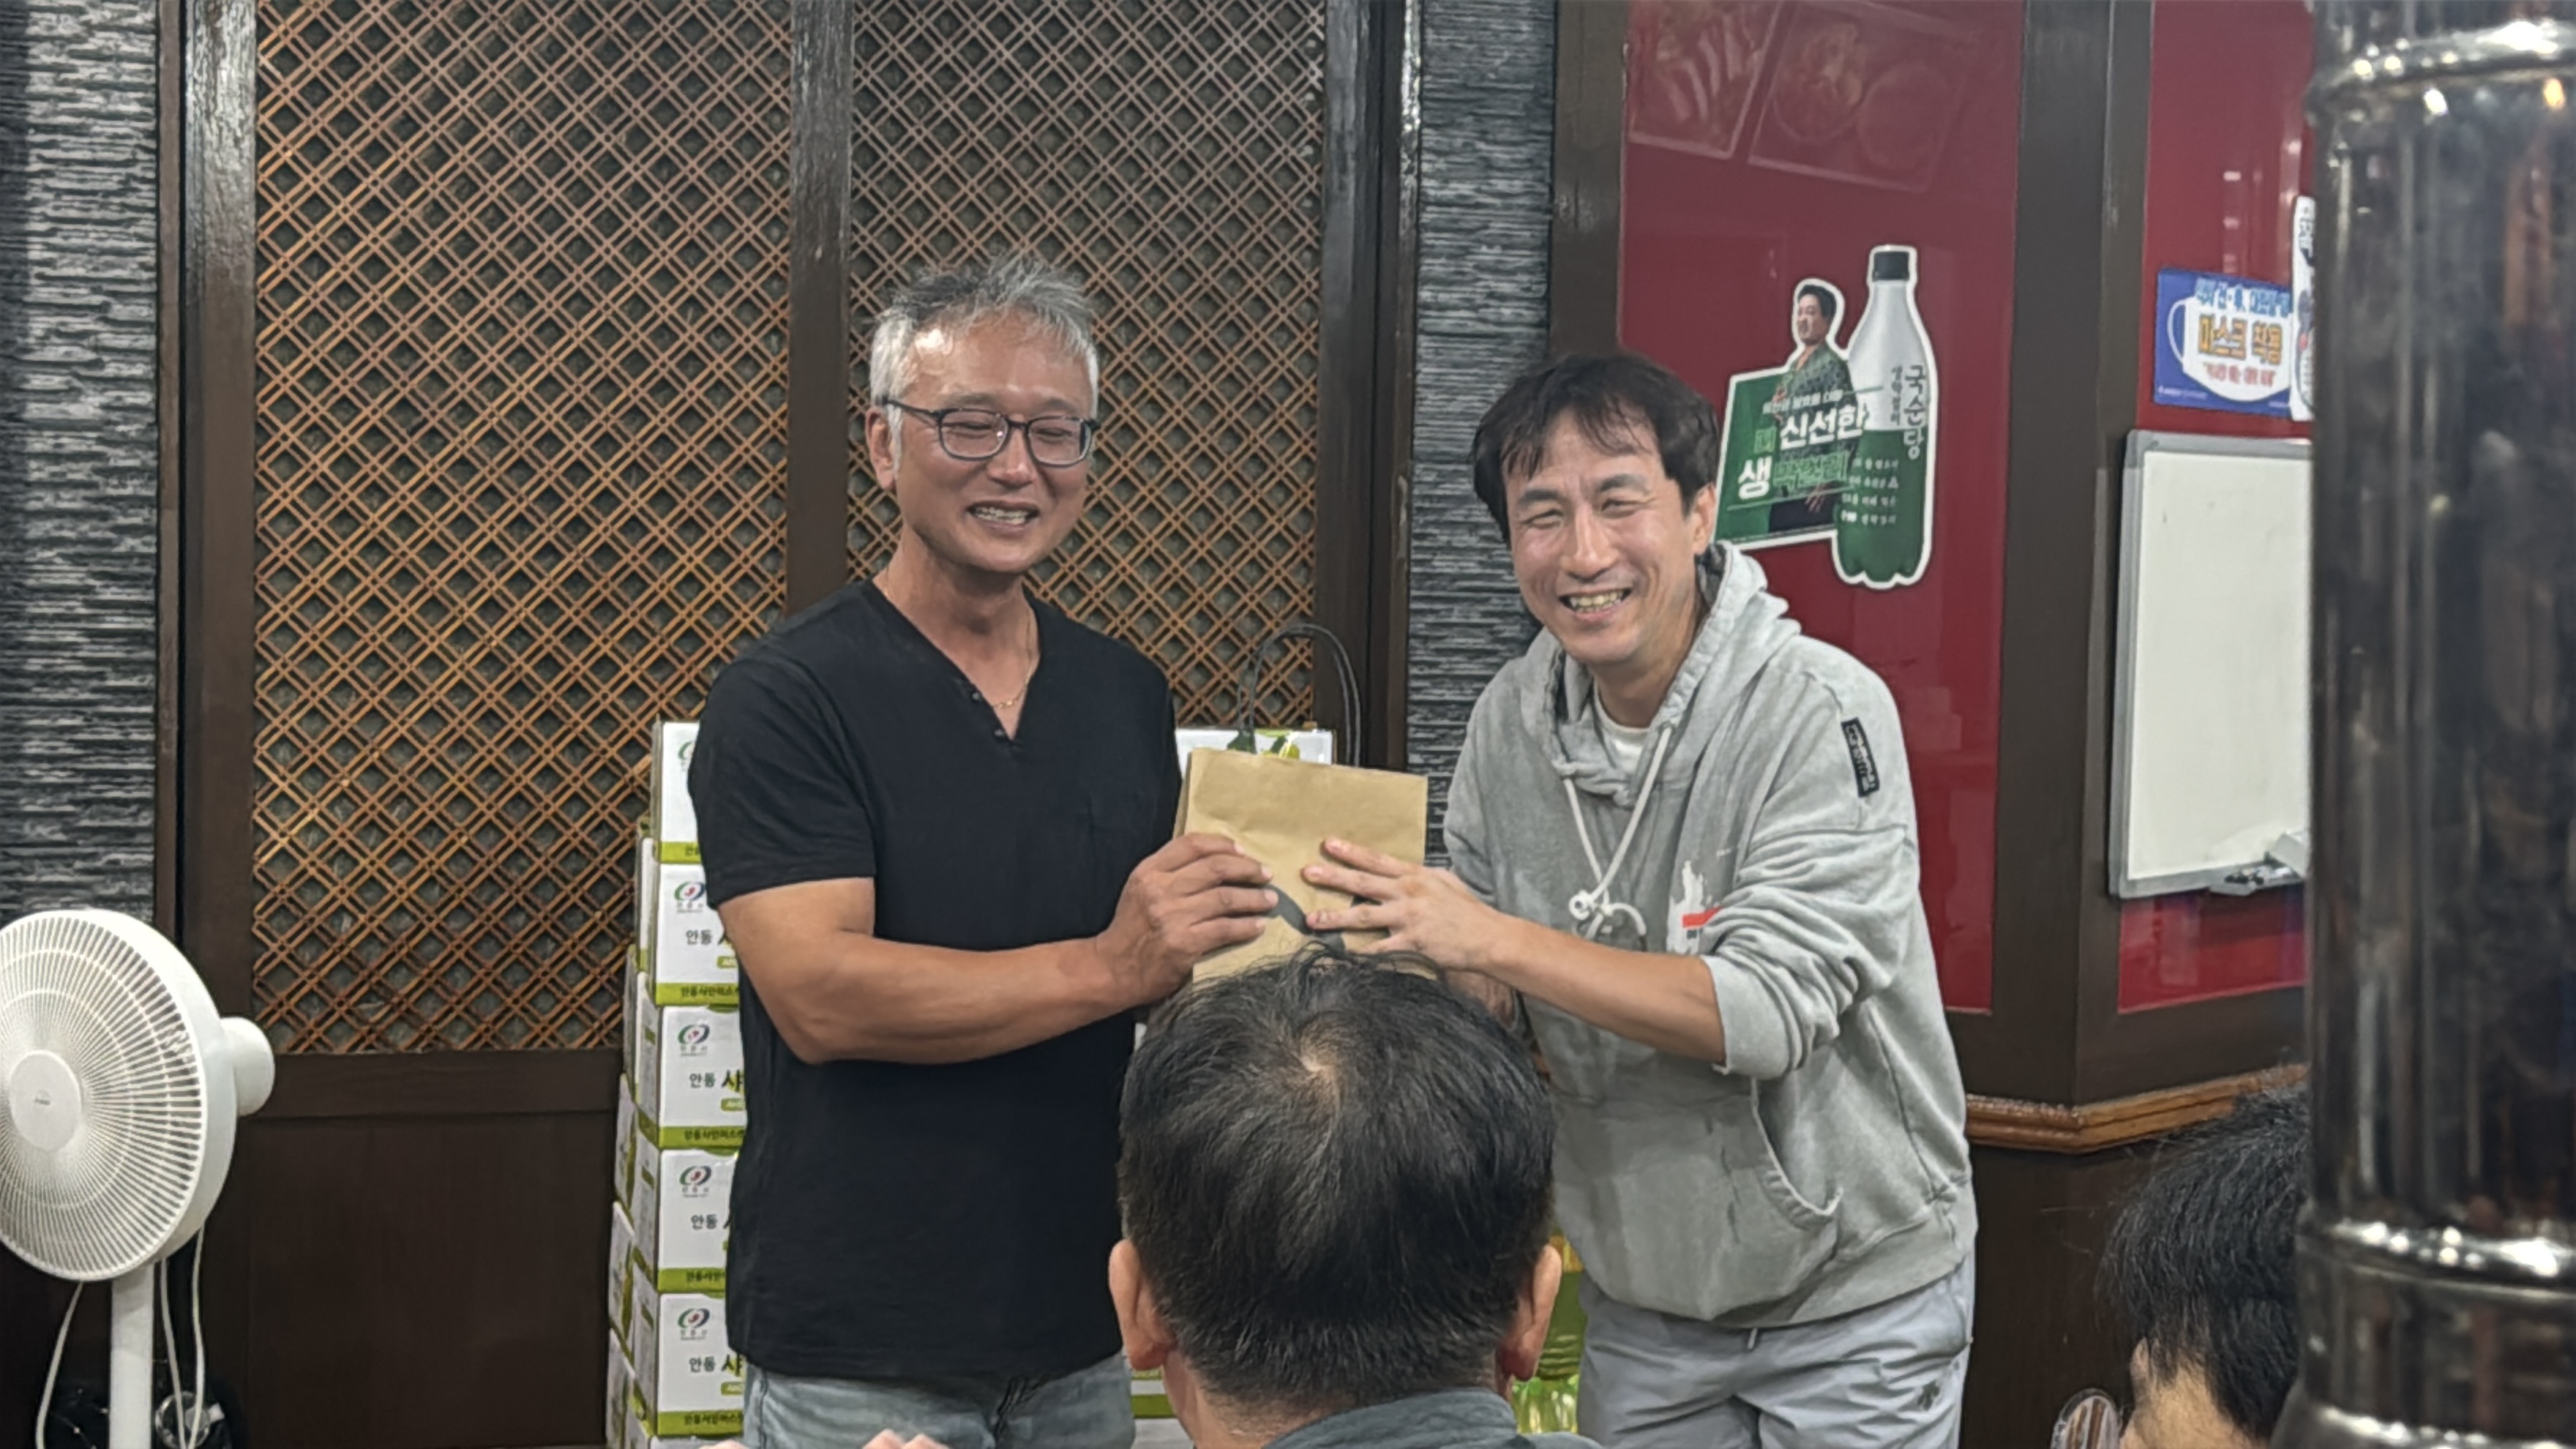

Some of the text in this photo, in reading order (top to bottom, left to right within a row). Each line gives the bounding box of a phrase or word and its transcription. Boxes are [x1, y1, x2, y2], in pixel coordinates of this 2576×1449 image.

[1903, 364, 1926, 460] 국순당
[1781, 405, 1865, 450] 신선한
[686, 929, 713, 945] 안동
[689, 1073, 715, 1088] 안동
[691, 1214, 717, 1229] 안동
[689, 1357, 715, 1372] 안동
